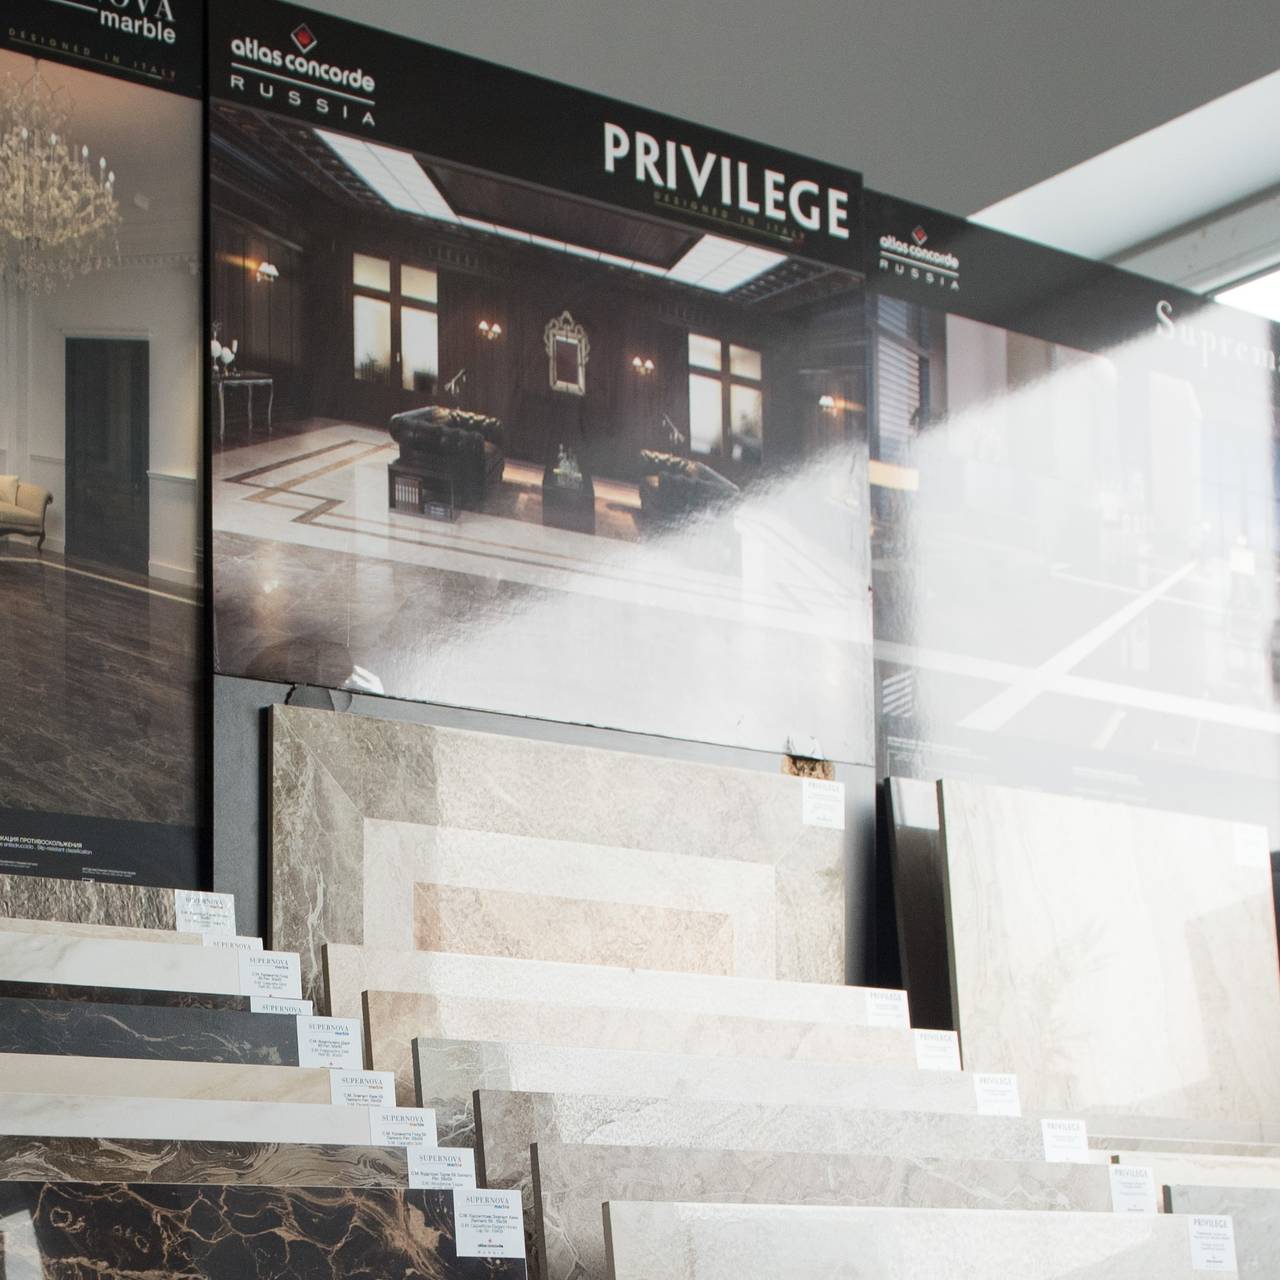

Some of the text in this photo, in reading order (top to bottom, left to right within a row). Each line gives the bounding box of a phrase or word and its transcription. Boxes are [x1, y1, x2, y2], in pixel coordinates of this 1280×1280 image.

[100, 9, 176, 44] marble
[231, 36, 376, 92] atlas concorde
[230, 74, 377, 127] RUSSIA
[603, 121, 850, 239] PRIVILEGE
[879, 234, 960, 270] atlas concorde
[879, 258, 960, 292] RUSSIA
[1155, 299, 1280, 372] Suprem
[249, 957, 289, 966] SUPERNOVA
[308, 1023, 349, 1032] SUPERNOVA
[341, 1076, 383, 1086] SUPERNOVA
[382, 1114, 424, 1123] SUPERNOVA
[420, 1154, 462, 1163] SUPERNOVA
[466, 1196, 510, 1205] SUPERNOVA
